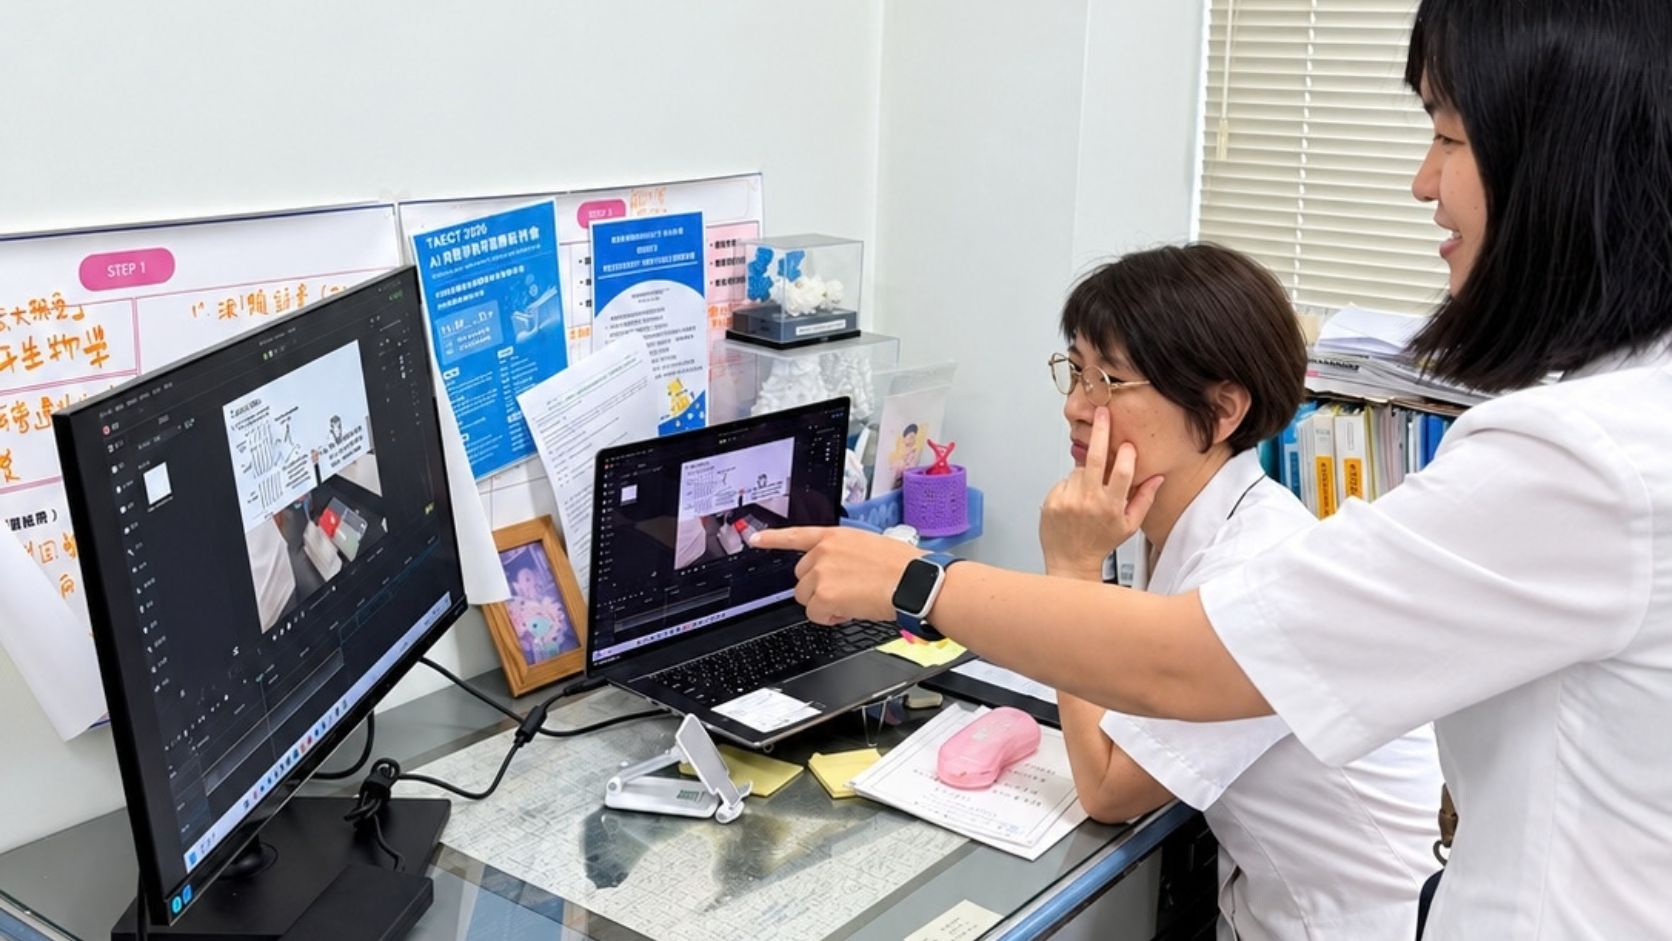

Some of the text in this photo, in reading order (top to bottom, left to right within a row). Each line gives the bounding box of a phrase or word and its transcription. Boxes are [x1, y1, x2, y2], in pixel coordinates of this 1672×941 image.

[426, 229, 462, 249] TAECT
[107, 261, 146, 278] STEP 1
